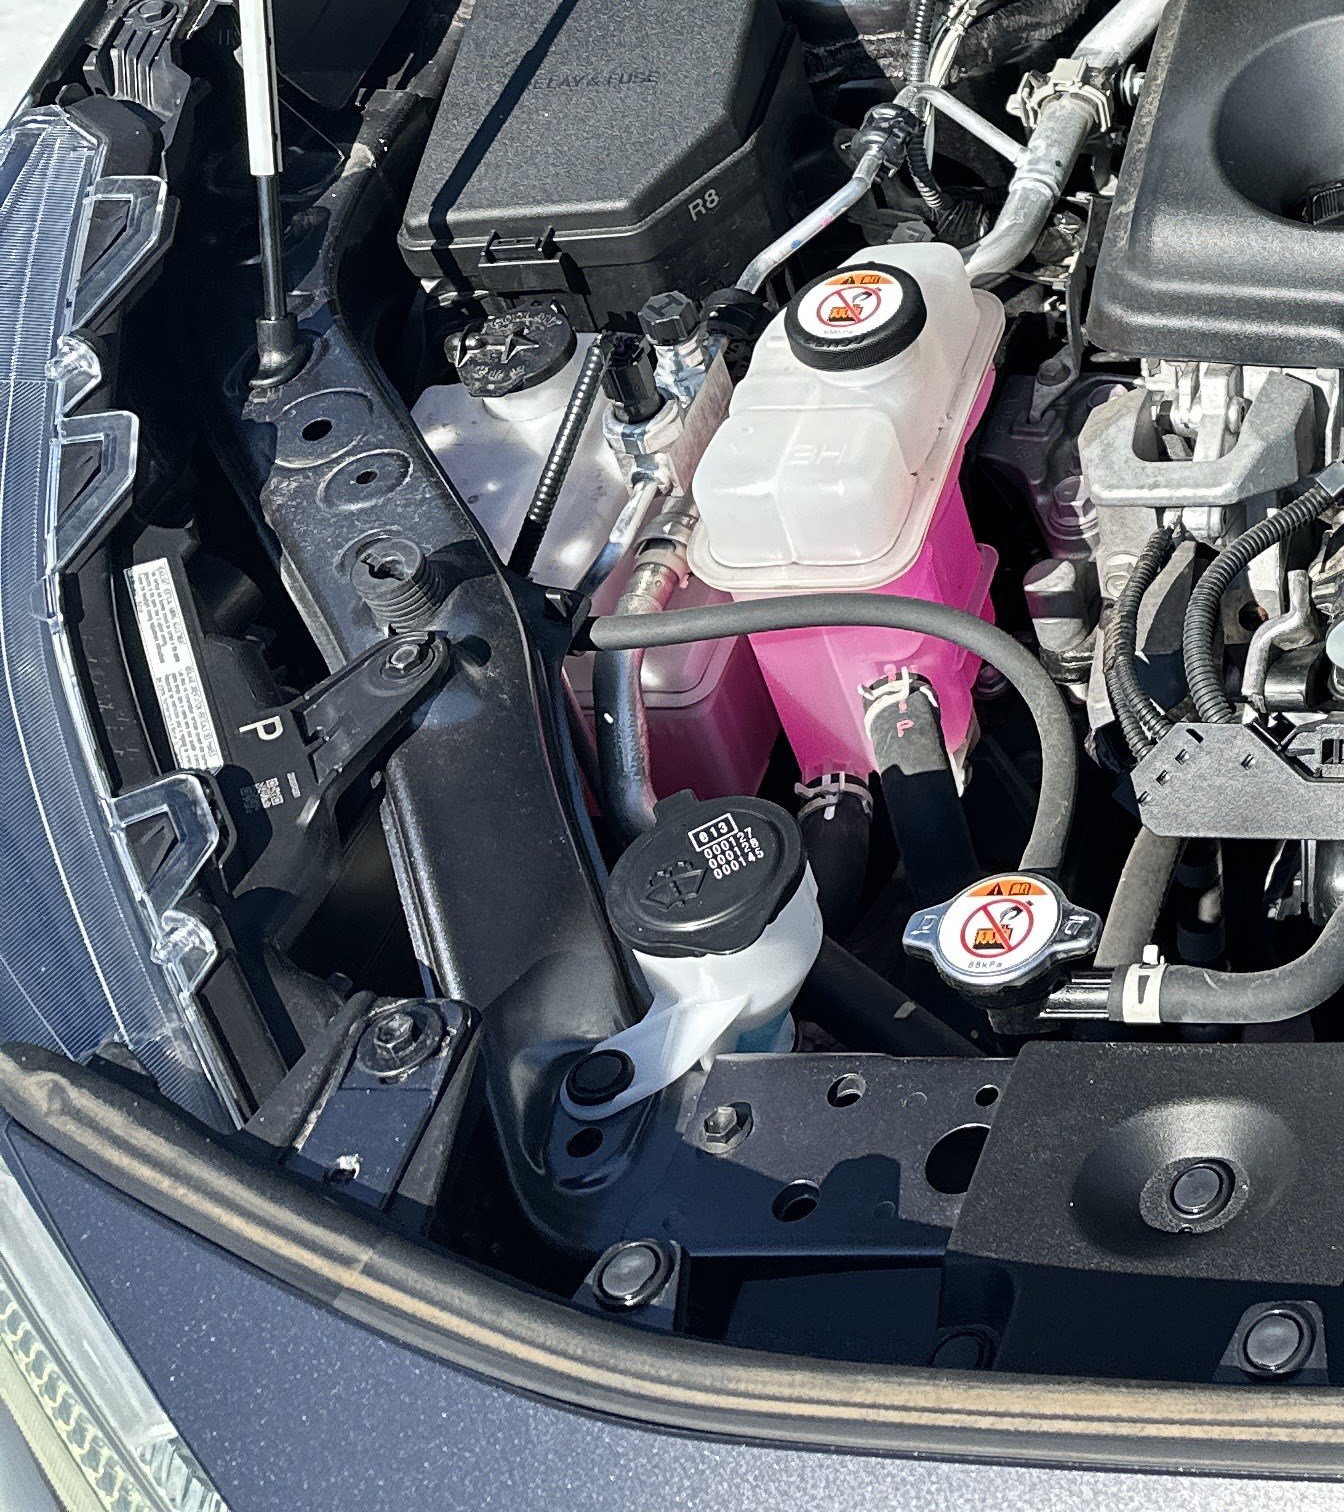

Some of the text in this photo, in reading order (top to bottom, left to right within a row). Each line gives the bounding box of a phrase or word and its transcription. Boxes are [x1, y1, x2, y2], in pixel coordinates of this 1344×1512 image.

[688, 189, 719, 222] R8
[238, 715, 284, 741] P
[703, 826, 752, 859] 000127
[708, 837, 759, 869] 000128
[713, 847, 764, 880] 000145
